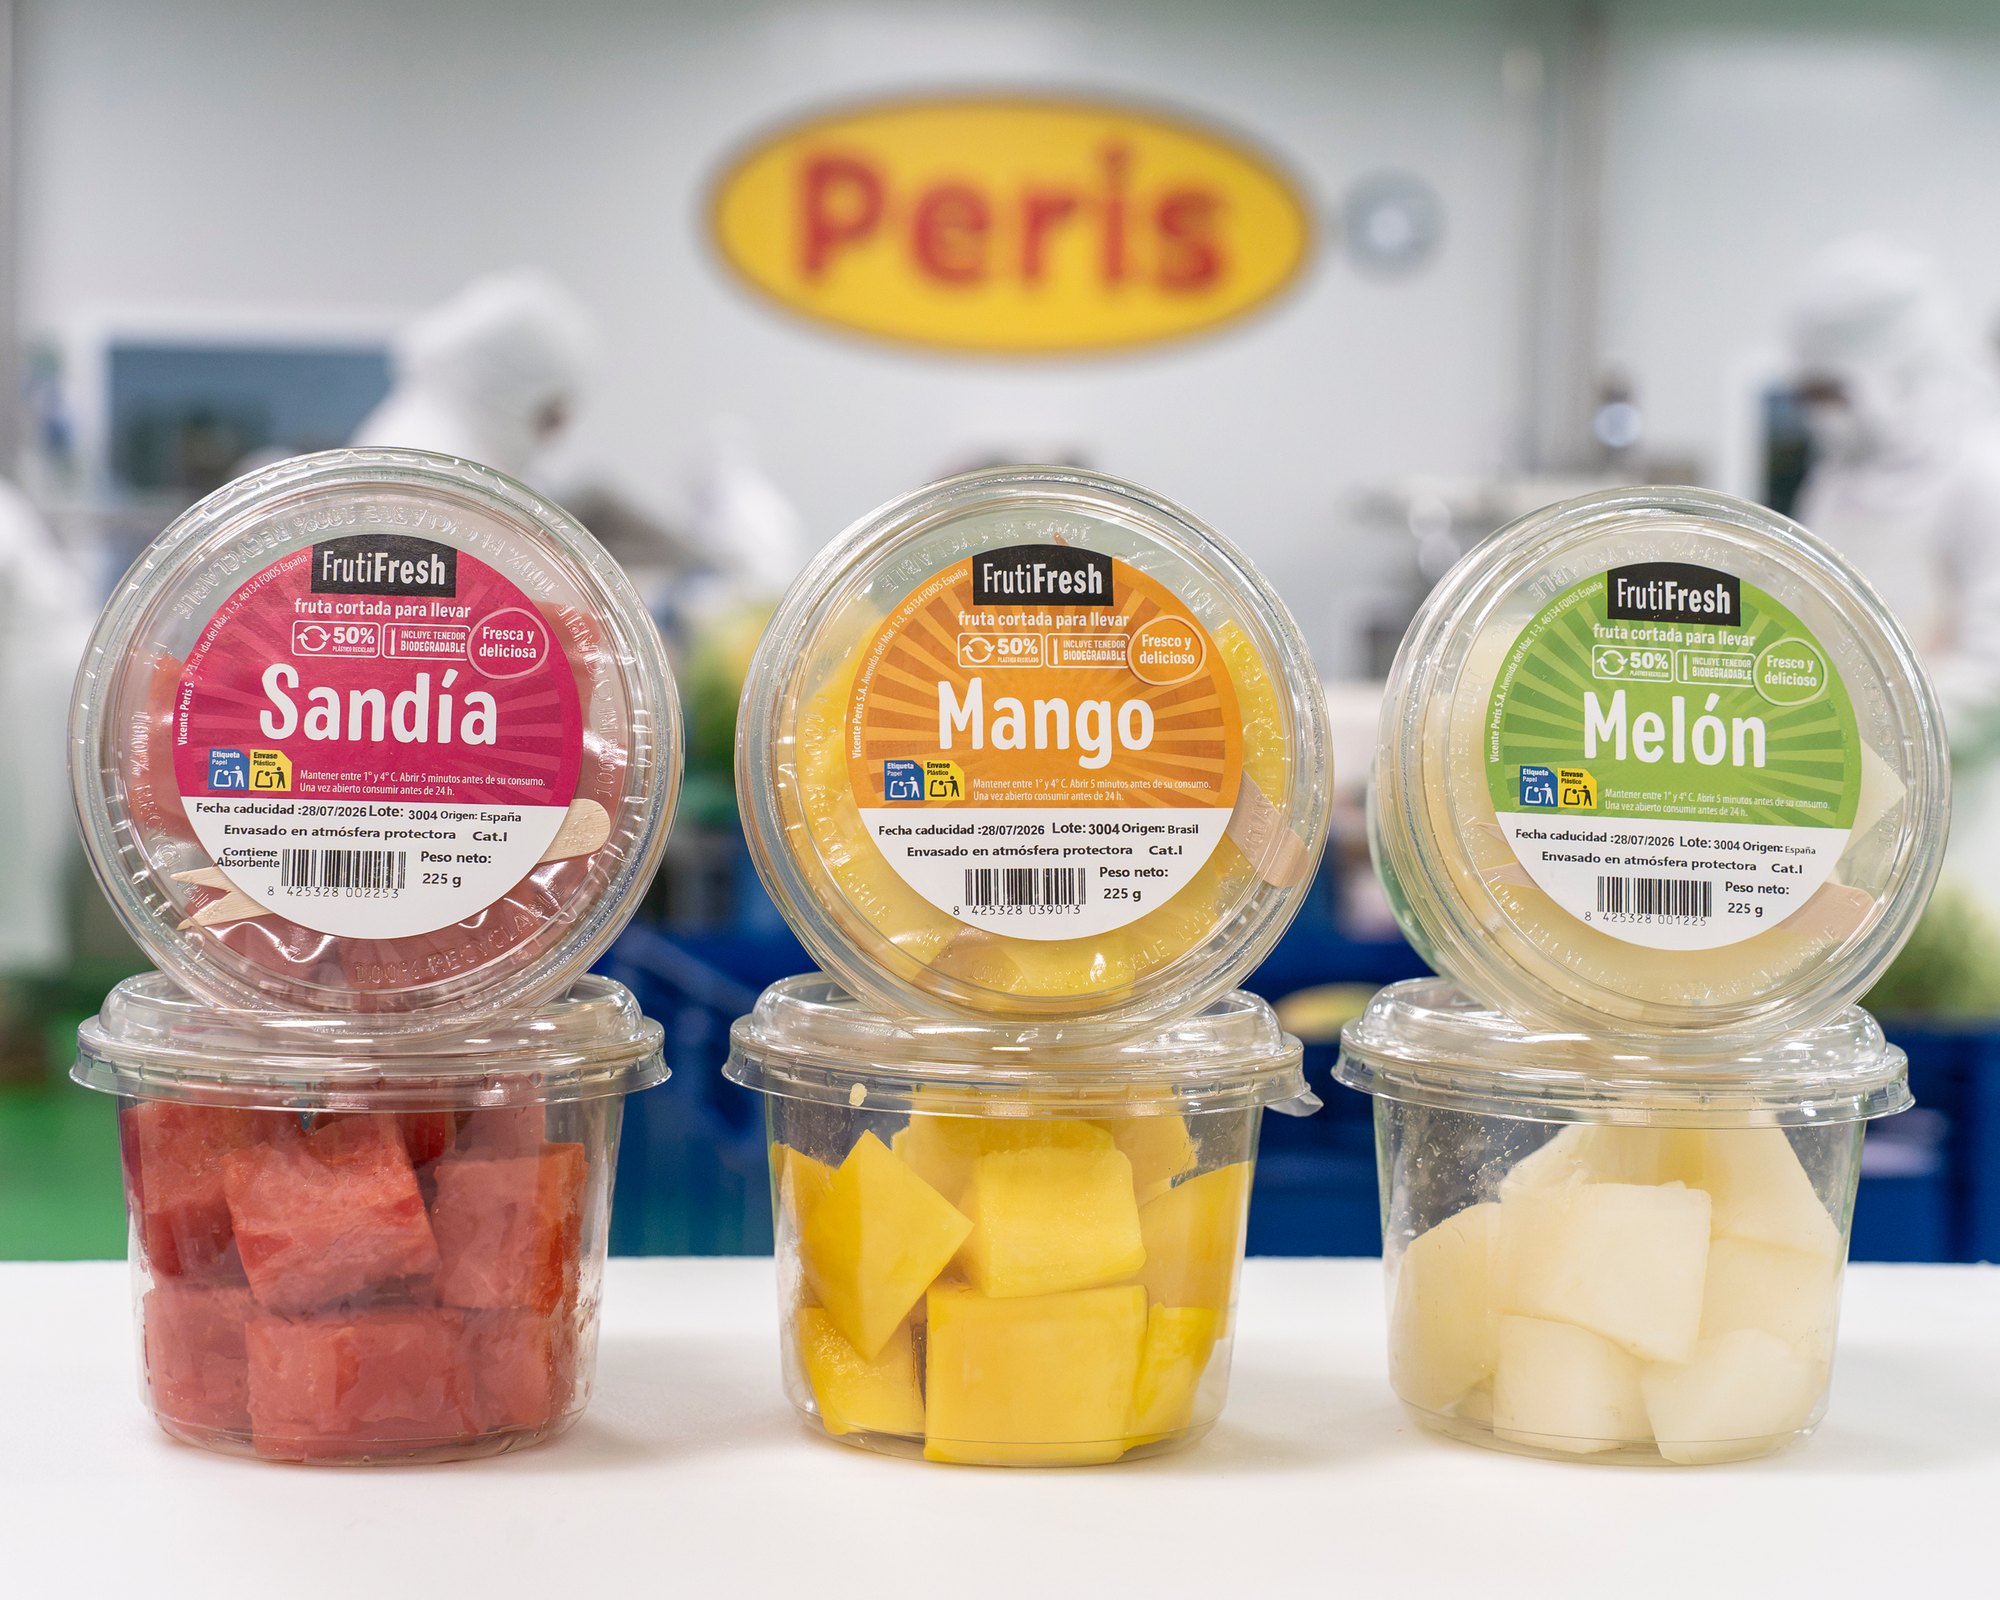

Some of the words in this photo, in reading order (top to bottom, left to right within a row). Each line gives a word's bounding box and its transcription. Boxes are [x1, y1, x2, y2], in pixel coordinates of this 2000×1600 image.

[796, 140, 1229, 292] Peris
[323, 551, 445, 585] FrutiFresh
[942, 569, 968, 587] España
[984, 563, 1102, 594] FrutiFresh
[1617, 578, 1730, 614] FrutiFresh
[295, 598, 331, 614] fruta
[336, 600, 391, 616] cortada
[395, 604, 426, 618] para
[431, 603, 471, 618] llevar
[903, 597, 924, 616] 46134
[958, 611, 994, 626] fruta
[998, 612, 1052, 626] cortada
[1056, 615, 1086, 629] para
[1091, 612, 1129, 626] llevar
[333, 627, 375, 644] 50%
[402, 631, 431, 639] INCLUYE
[433, 632, 465, 640] TENEDOR
[483, 626, 523, 640] Fresca
[527, 630, 534, 644] y
[881, 626, 897, 644] Mar,
[1142, 634, 1181, 647] Fresco
[1185, 636, 1191, 650] y
[1593, 624, 1627, 639] fruta
[1631, 626, 1682, 642] cortada
[1686, 631, 1715, 645] para
[1719, 631, 1756, 646] llevar
[401, 641, 465, 653] BIODEGRADABLE
[479, 644, 536, 658] deliciosa
[874, 640, 885, 655] del
[998, 638, 1038, 655] 50%
[1064, 640, 1092, 648] INCLUYE
[1094, 640, 1125, 648] TENEDOR
[1063, 650, 1126, 660] BIODEGRADABLE
[1140, 651, 1195, 664] delicioso
[1630, 652, 1668, 669] 50%
[1693, 657, 1720, 666] INCLUYE
[1722, 658, 1751, 668] TENEDOR
[861, 655, 879, 684] Avenida
[1767, 655, 1804, 669] Fresco
[1807, 660, 1814, 673] y
[1692, 667, 1752, 680] BIODEGRADABLE
[1765, 672, 1817, 686] delicioso
[857, 685, 868, 701] S.A.
[259, 663, 496, 744] Sandía
[853, 703, 863, 724] Peris
[938, 677, 1154, 769] Mango
[1583, 689, 1766, 767] Melón
[852, 726, 861, 758] Vicente
[212, 751, 240, 759] Etiqueta
[300, 770, 338, 781] Mantener
[341, 772, 362, 781] entre
[373, 774, 378, 783] y
[400, 773, 419, 782] Abrir
[421, 773, 426, 782] 5
[428, 774, 460, 784] minutos
[462, 775, 483, 784] antes
[485, 775, 495, 785] de
[497, 776, 506, 785] su
[508, 778, 545, 786] consumo.
[1523, 768, 1548, 776] Etiqueta
[1561, 770, 1583, 778] Envase
[300, 782, 315, 792] Una
[332, 783, 360, 793] abierto
[362, 785, 398, 794] consumir
[400, 787, 422, 795] antes
[424, 786, 433, 795] de
[435, 787, 444, 795] 24
[446, 787, 455, 796] h.
[974, 792, 989, 800] Una
[1005, 791, 1032, 800] abierto
[1034, 791, 1069, 800] consumir
[1071, 792, 1092, 800] antes
[1094, 791, 1103, 800] de
[1105, 792, 1114, 800] 24
[1116, 791, 1124, 800] h.
[196, 803, 230, 813] Fecha
[234, 804, 294, 815] caducidad
[369, 805, 403, 817] Lote:
[408, 810, 438, 820] 3004
[440, 811, 477, 822] Origen:
[480, 812, 521, 824] España
[224, 825, 286, 835] Envasado
[291, 828, 307, 836] en
[312, 826, 379, 838] atmósfera
[385, 828, 456, 840] protectora
[879, 825, 912, 835] Fecha
[915, 824, 974, 835] caducidad
[1052, 822, 1086, 833] Lote:
[1089, 824, 1120, 835] 3004
[1122, 823, 1165, 835] Origen:
[1168, 825, 1198, 834] Brasil
[1516, 829, 1547, 839] Fecha
[1550, 831, 1607, 842] caducidad
[1680, 836, 1711, 848] Lote:
[1714, 840, 1740, 850] 3004
[1743, 841, 1783, 854] Origen:
[1785, 846, 1816, 855] España
[223, 848, 278, 857] Contiene
[421, 851, 452, 862] Peso
[457, 854, 492, 864] neto:
[908, 846, 968, 856] Envasado
[973, 848, 988, 856] en
[993, 845, 1059, 856] atmósfera
[1064, 845, 1132, 857] protectora
[216, 857, 280, 868] Absorbente
[1542, 851, 1601, 863] Envasado
[1605, 856, 1620, 864] en
[1625, 856, 1688, 867] atmósfera
[1692, 860, 1756, 870] protectora
[1100, 867, 1130, 877] Peso
[1135, 868, 1169, 877] neto:
[422, 873, 448, 884] 225
[452, 876, 461, 887] g
[1726, 881, 1753, 892] Peso
[1758, 885, 1789, 894] neto:
[268, 886, 274, 896] 8
[287, 887, 339, 897] 425328
[346, 888, 399, 898] 002253
[1104, 888, 1128, 899] 225
[1133, 890, 1141, 901] g
[953, 906, 960, 915] 8
[972, 906, 1022, 915] 425328
[1029, 905, 1081, 915] 039013
[1728, 902, 1750, 914] 225
[1755, 905, 1763, 917] g
[1585, 912, 1591, 921] 8
[1603, 913, 1651, 923] 425328
[1658, 916, 1706, 926] 001225
